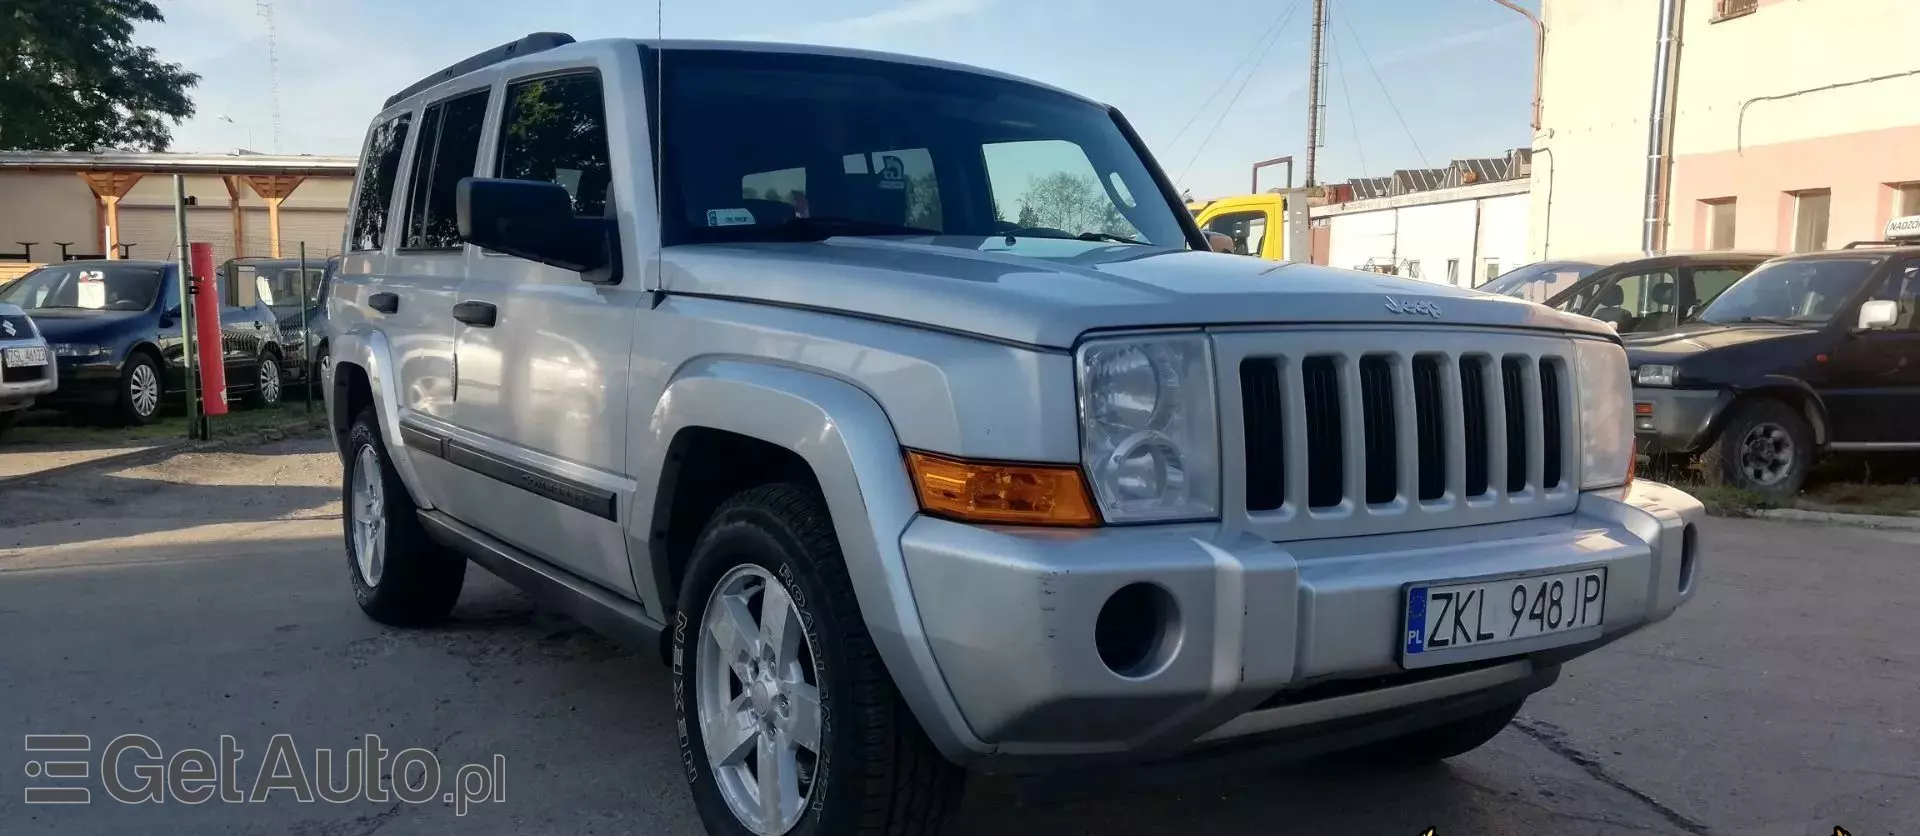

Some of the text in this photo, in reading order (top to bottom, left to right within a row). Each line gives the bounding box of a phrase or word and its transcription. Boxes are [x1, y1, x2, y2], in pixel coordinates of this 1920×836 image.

[1384, 295, 1441, 319] Jeep
[1428, 574, 1600, 648] ZKL 948JP
[1408, 630, 1422, 644] PL
[673, 610, 698, 783] NEXEN
